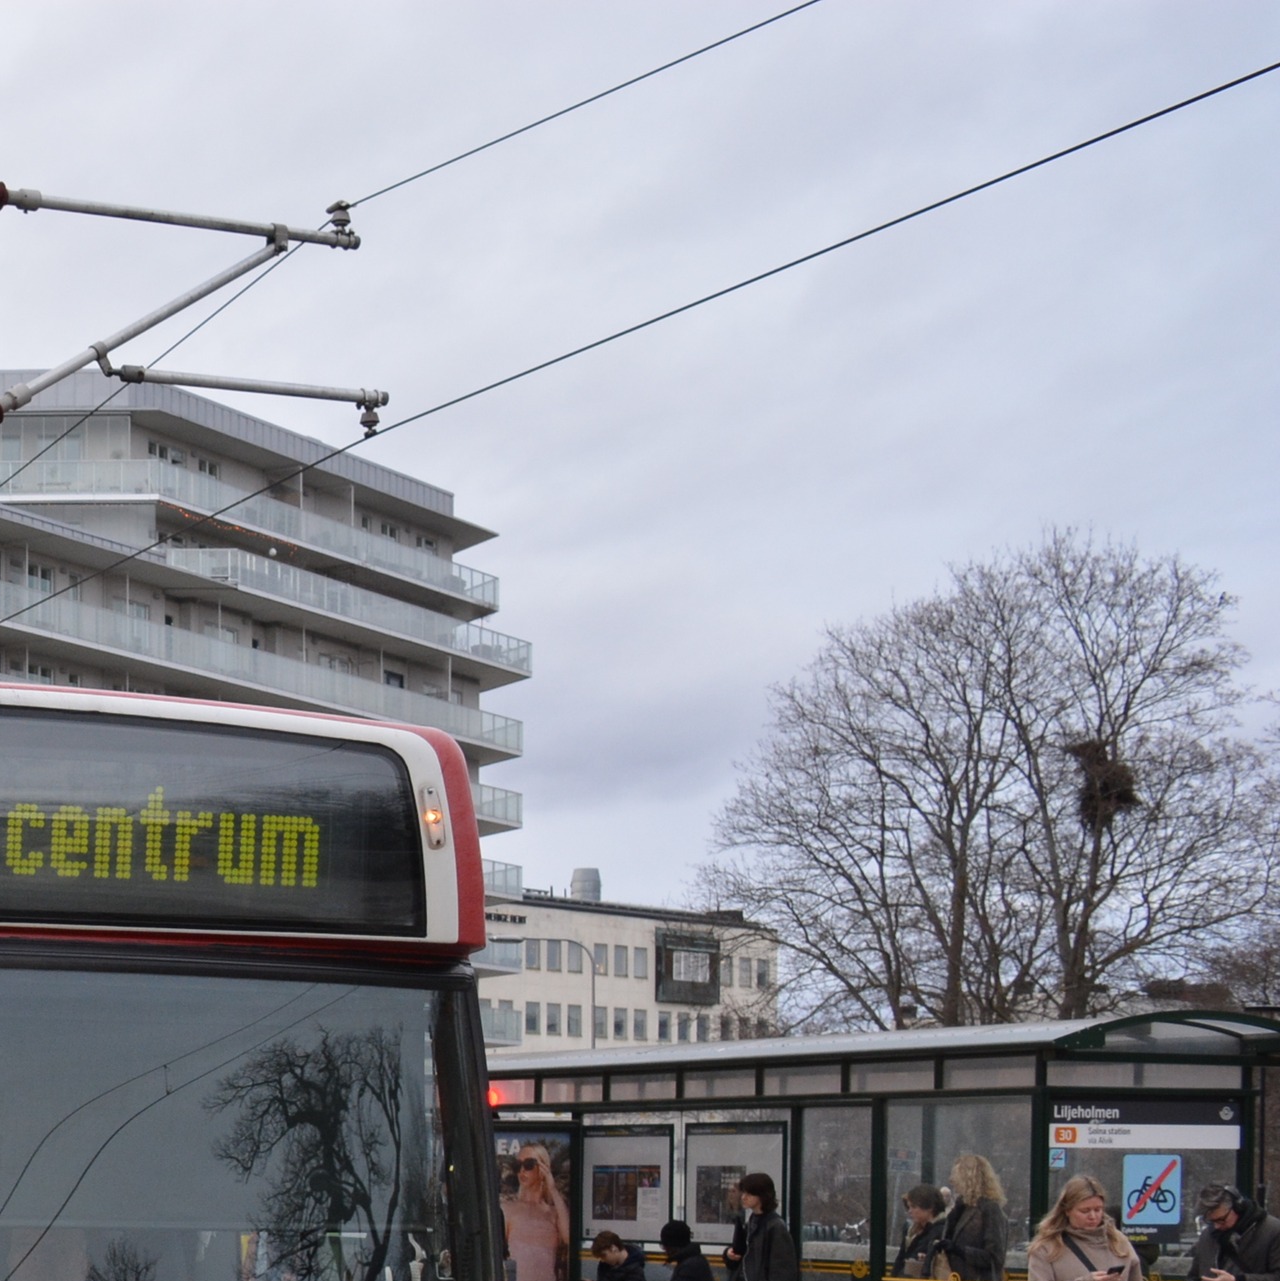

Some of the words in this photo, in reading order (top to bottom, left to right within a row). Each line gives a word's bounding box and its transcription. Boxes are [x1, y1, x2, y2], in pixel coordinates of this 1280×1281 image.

[5, 785, 320, 888] centrum
[1053, 1105, 1120, 1121] Liljeholmen
[1059, 1130, 1072, 1141] 30
[1088, 1127, 1107, 1135] Solna
[1107, 1127, 1131, 1135] station
[1098, 1136, 1113, 1144] Alvik
